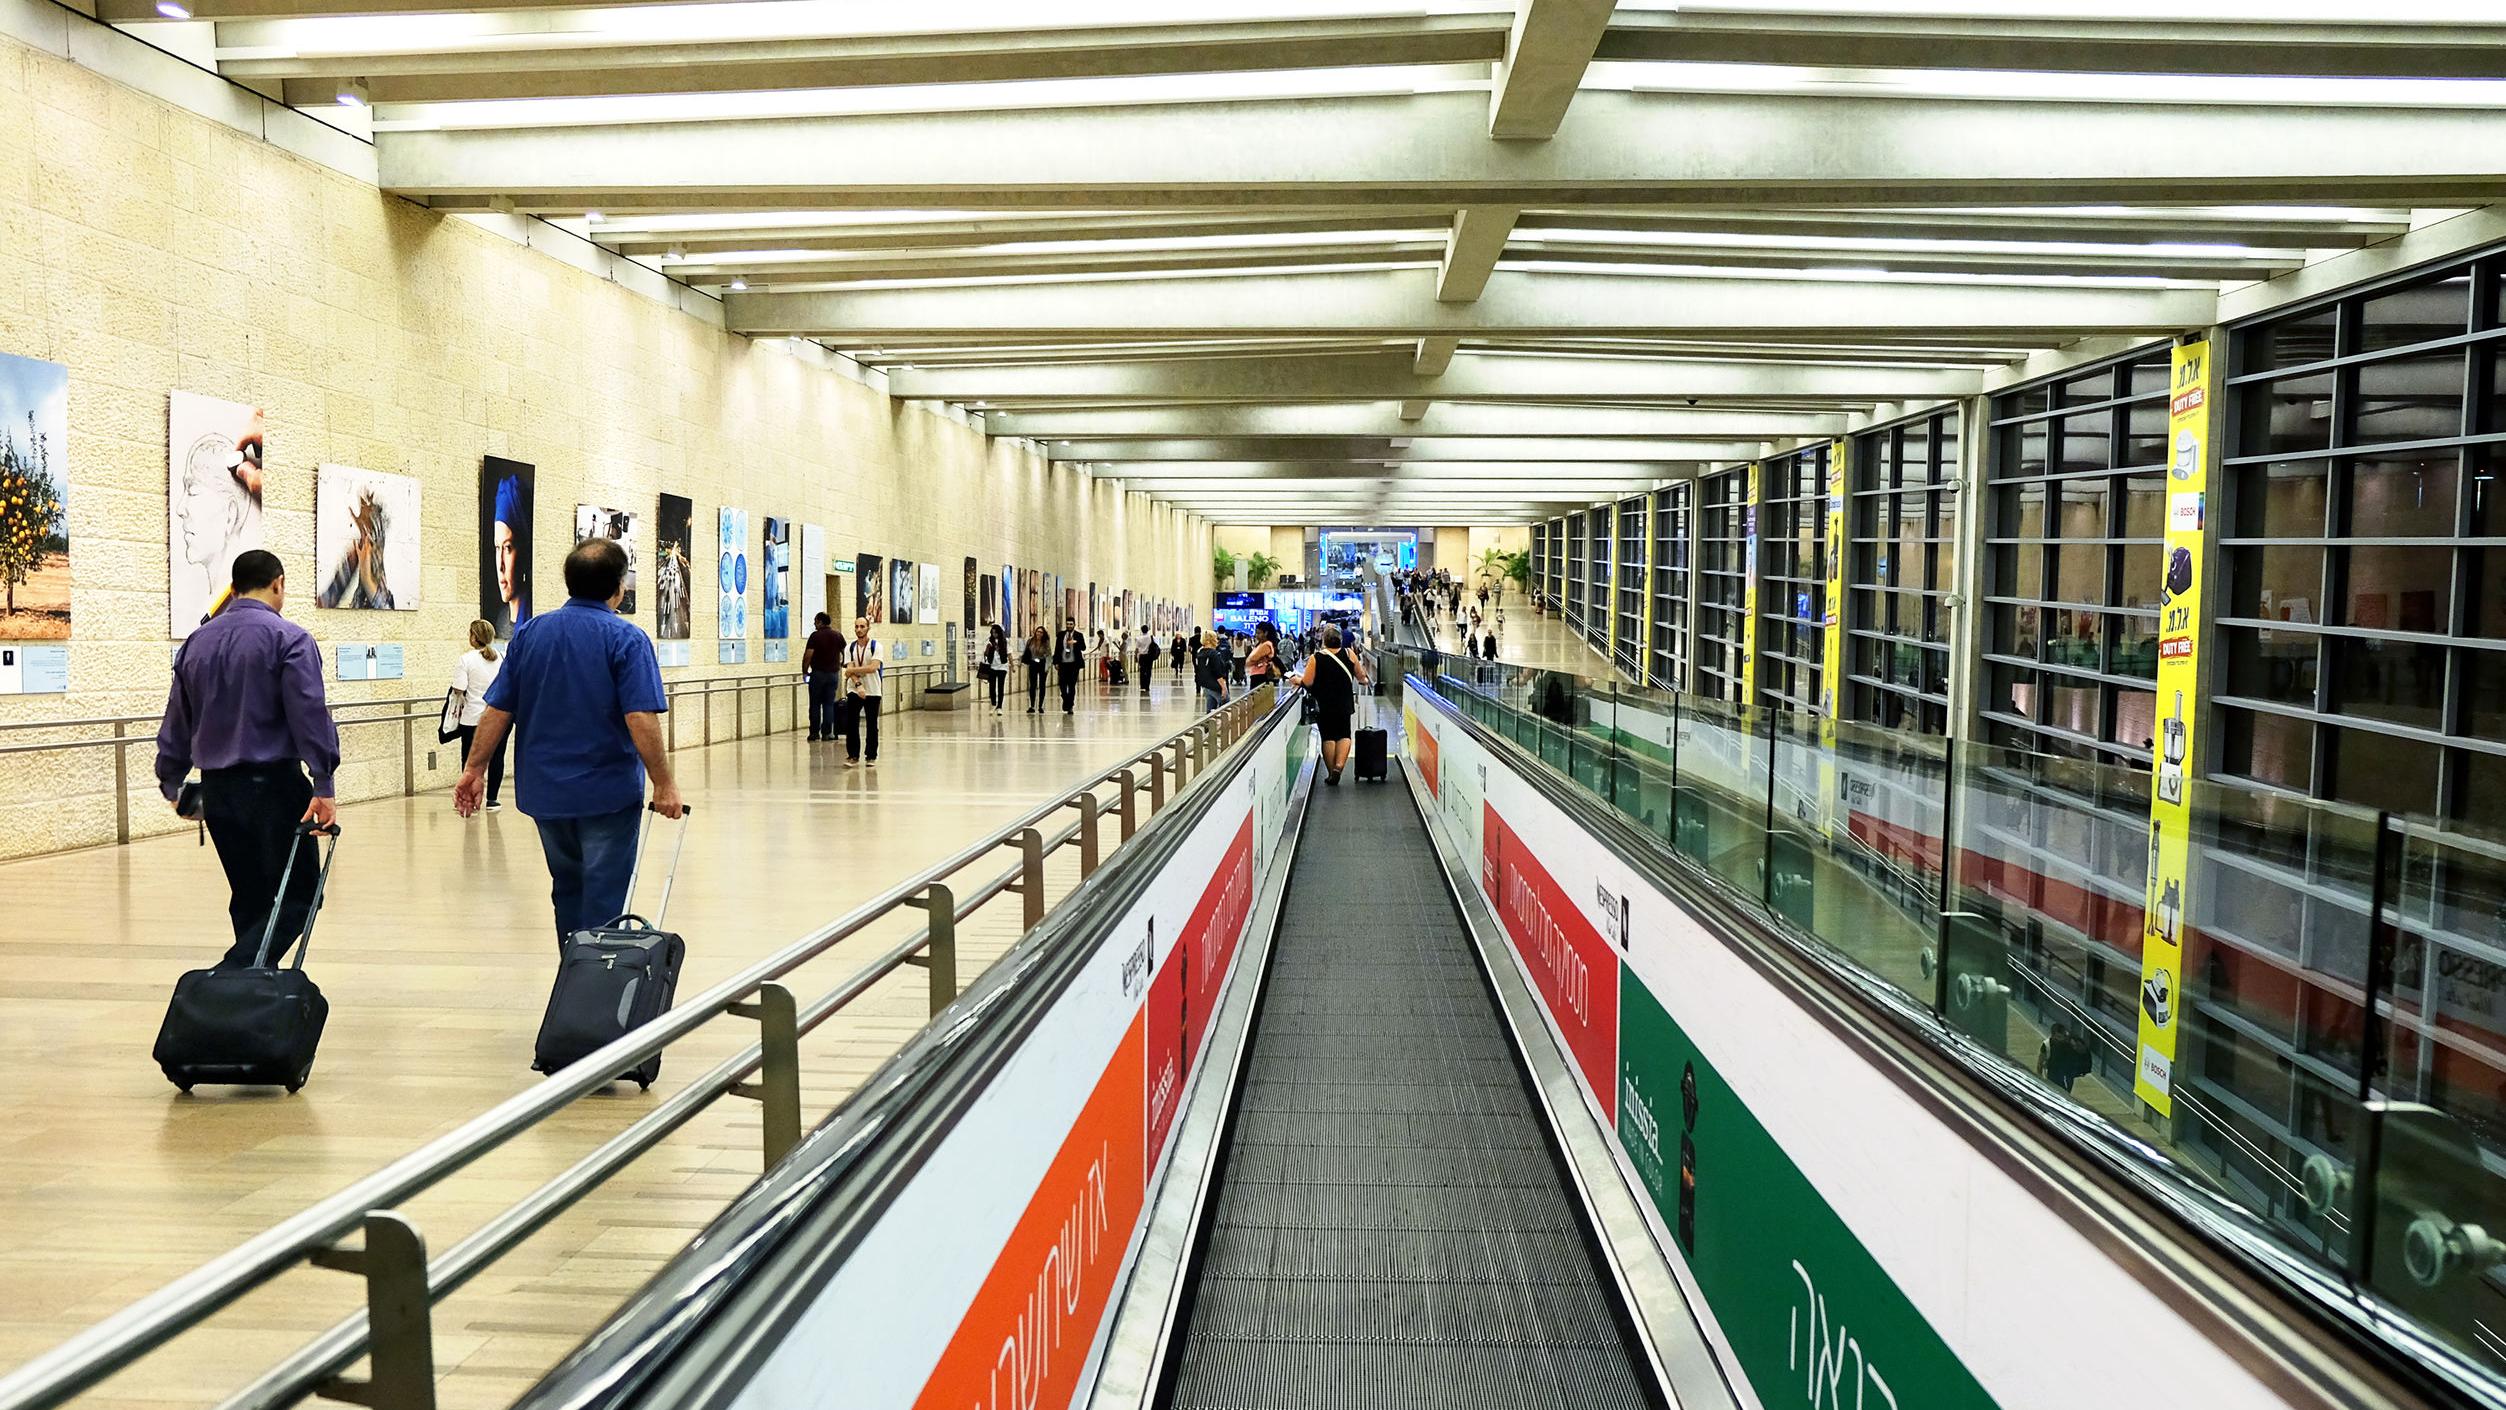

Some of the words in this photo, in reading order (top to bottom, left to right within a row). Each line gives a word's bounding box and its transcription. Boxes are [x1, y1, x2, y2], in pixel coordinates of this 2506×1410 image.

[2173, 395, 2188, 414] DUTY
[2188, 389, 2203, 408] FREE
[2180, 507, 2196, 516] BOSCH
[2162, 641, 2177, 656] DUTY
[2177, 640, 2191, 654] FREE
[2151, 1062, 2167, 1080] BOSCH
[1624, 1060, 1664, 1166] inissia
